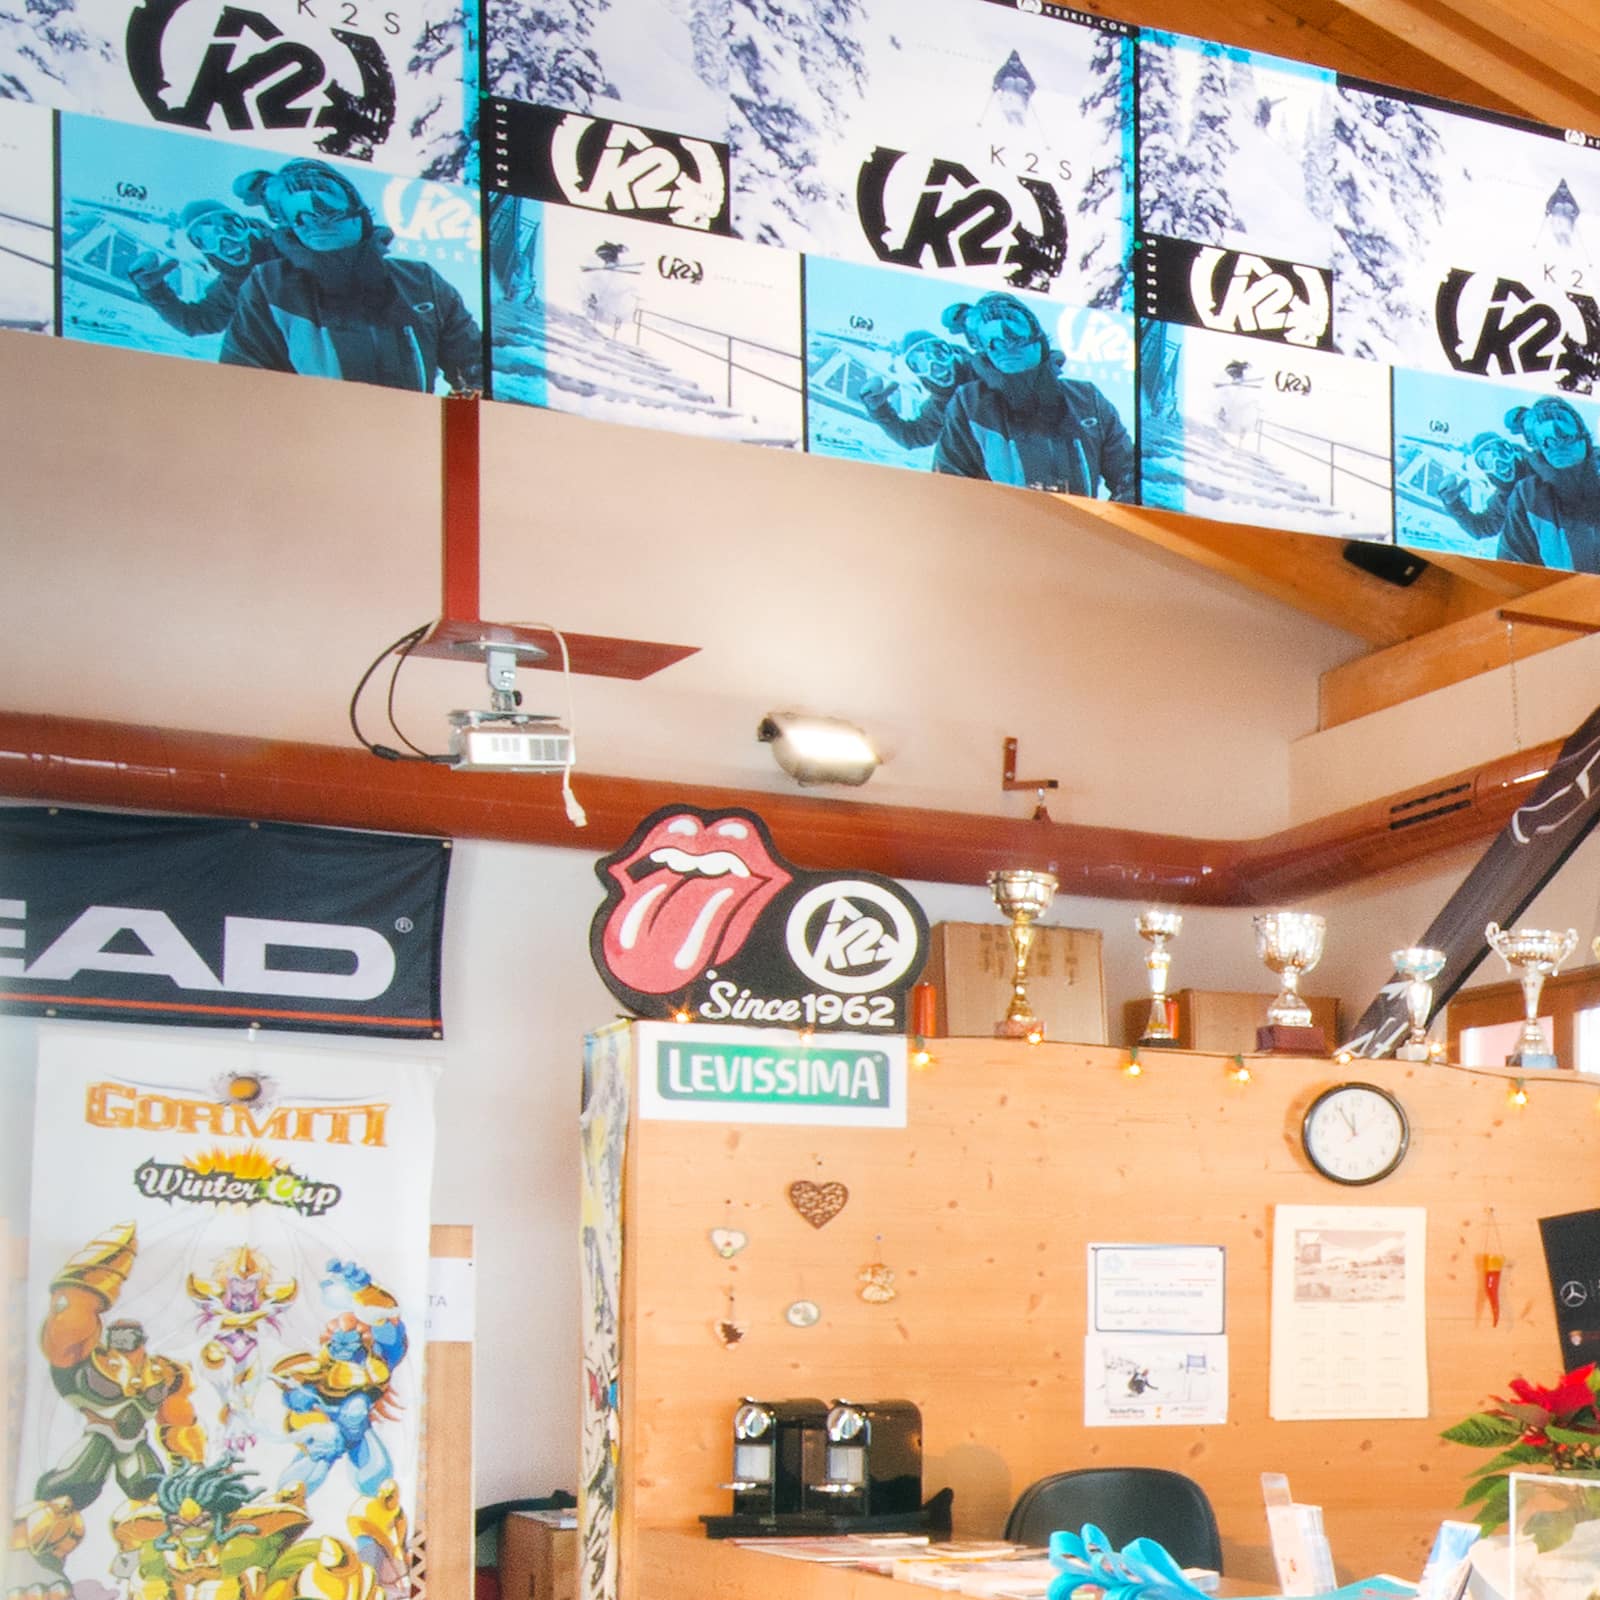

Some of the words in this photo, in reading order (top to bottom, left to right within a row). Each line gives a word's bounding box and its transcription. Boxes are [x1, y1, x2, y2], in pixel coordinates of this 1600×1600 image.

[0, 899, 396, 1001] AD
[699, 969, 802, 1022] Since
[801, 994, 896, 1027] 1962
[669, 1049, 881, 1101] LEVISSIMA
[85, 1081, 391, 1148] GORMITI
[138, 1164, 260, 1199] Winter
[264, 1173, 341, 1213] Cup
